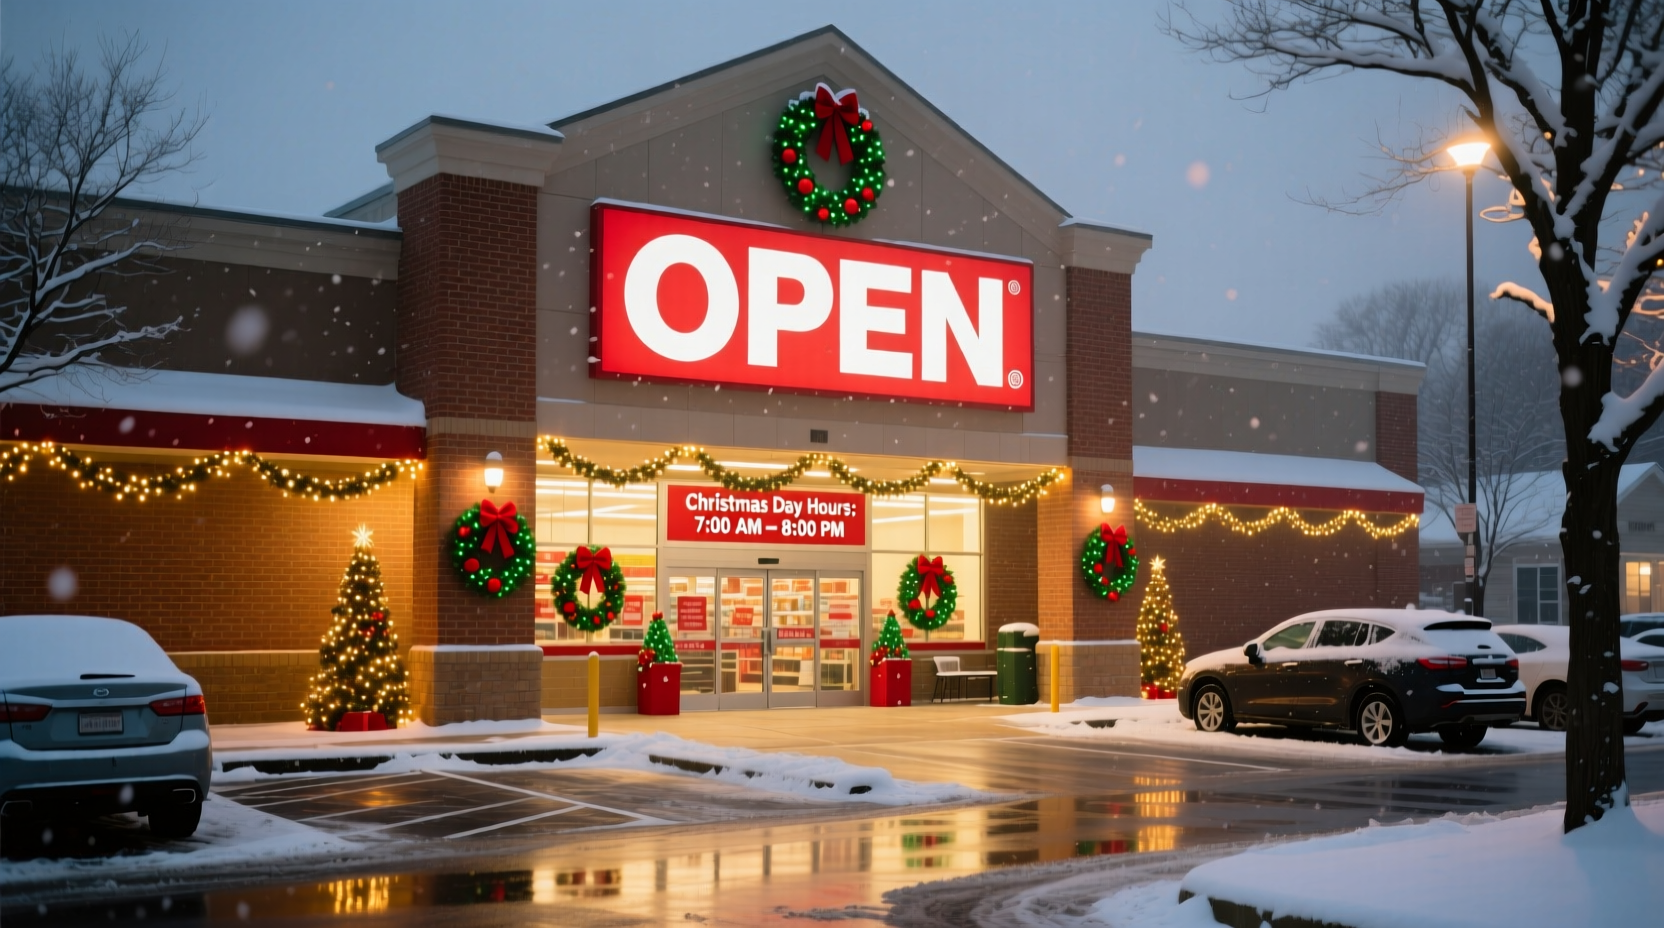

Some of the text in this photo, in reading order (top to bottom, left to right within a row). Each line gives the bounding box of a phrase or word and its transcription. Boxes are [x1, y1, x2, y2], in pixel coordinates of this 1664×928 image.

[624, 234, 1003, 387] OPEN
[685, 492, 768, 513] Christmas
[772, 496, 803, 518] Day
[694, 515, 731, 534] 7:00
[735, 517, 762, 535] AM
[781, 519, 817, 537] 8:00
[820, 520, 845, 538] PM
